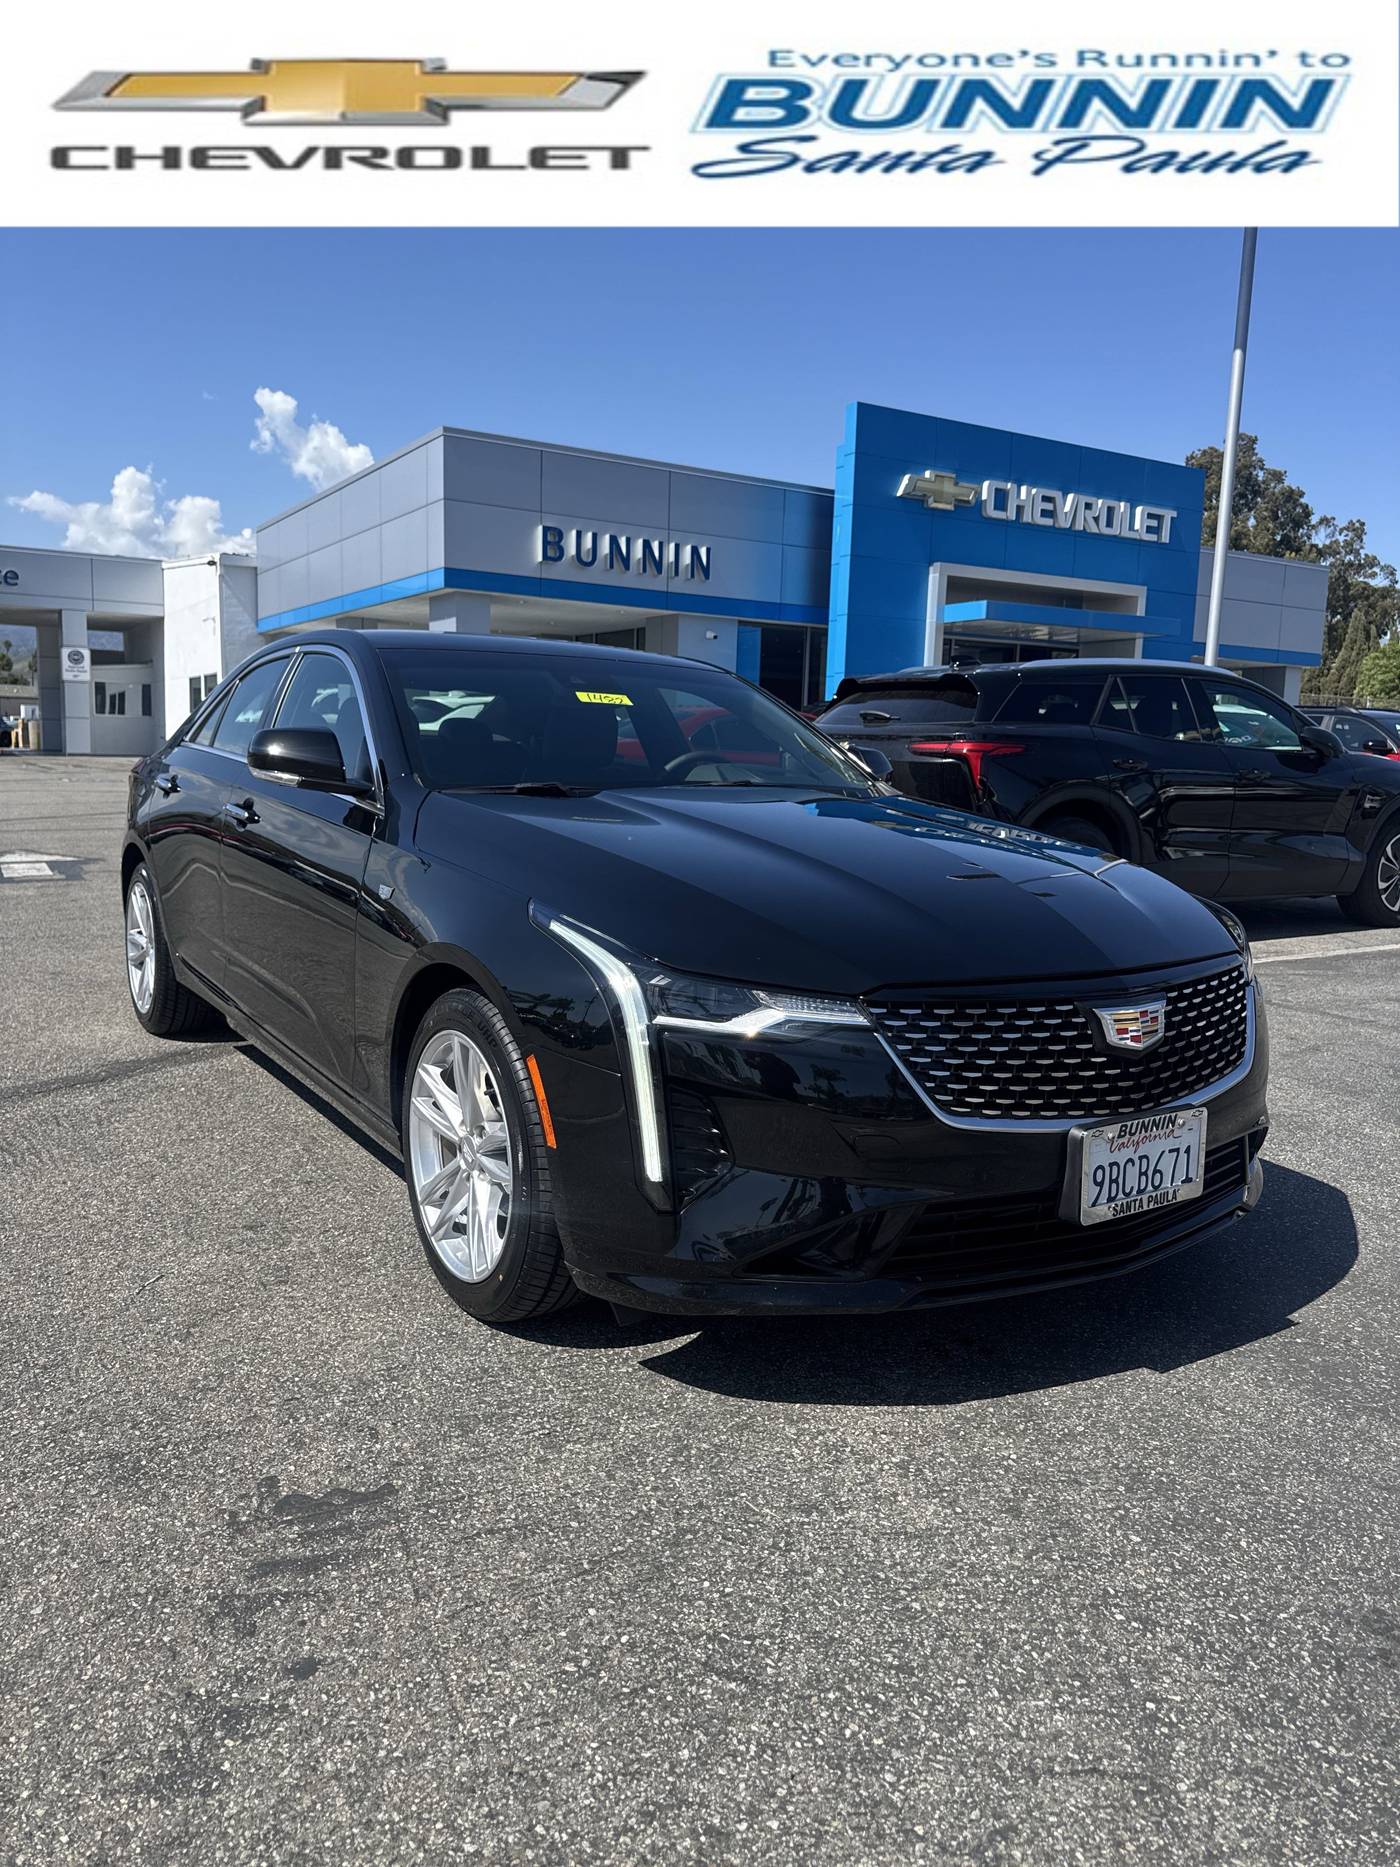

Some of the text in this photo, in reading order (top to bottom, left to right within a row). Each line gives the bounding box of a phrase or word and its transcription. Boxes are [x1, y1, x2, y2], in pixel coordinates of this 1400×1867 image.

[981, 480, 1177, 543] CHEVROLET
[538, 525, 711, 580] BUNNIN
[1108, 1128, 1182, 1153] California
[1117, 1114, 1177, 1139] BUNNIN
[1091, 1145, 1193, 1208] 9BCB671
